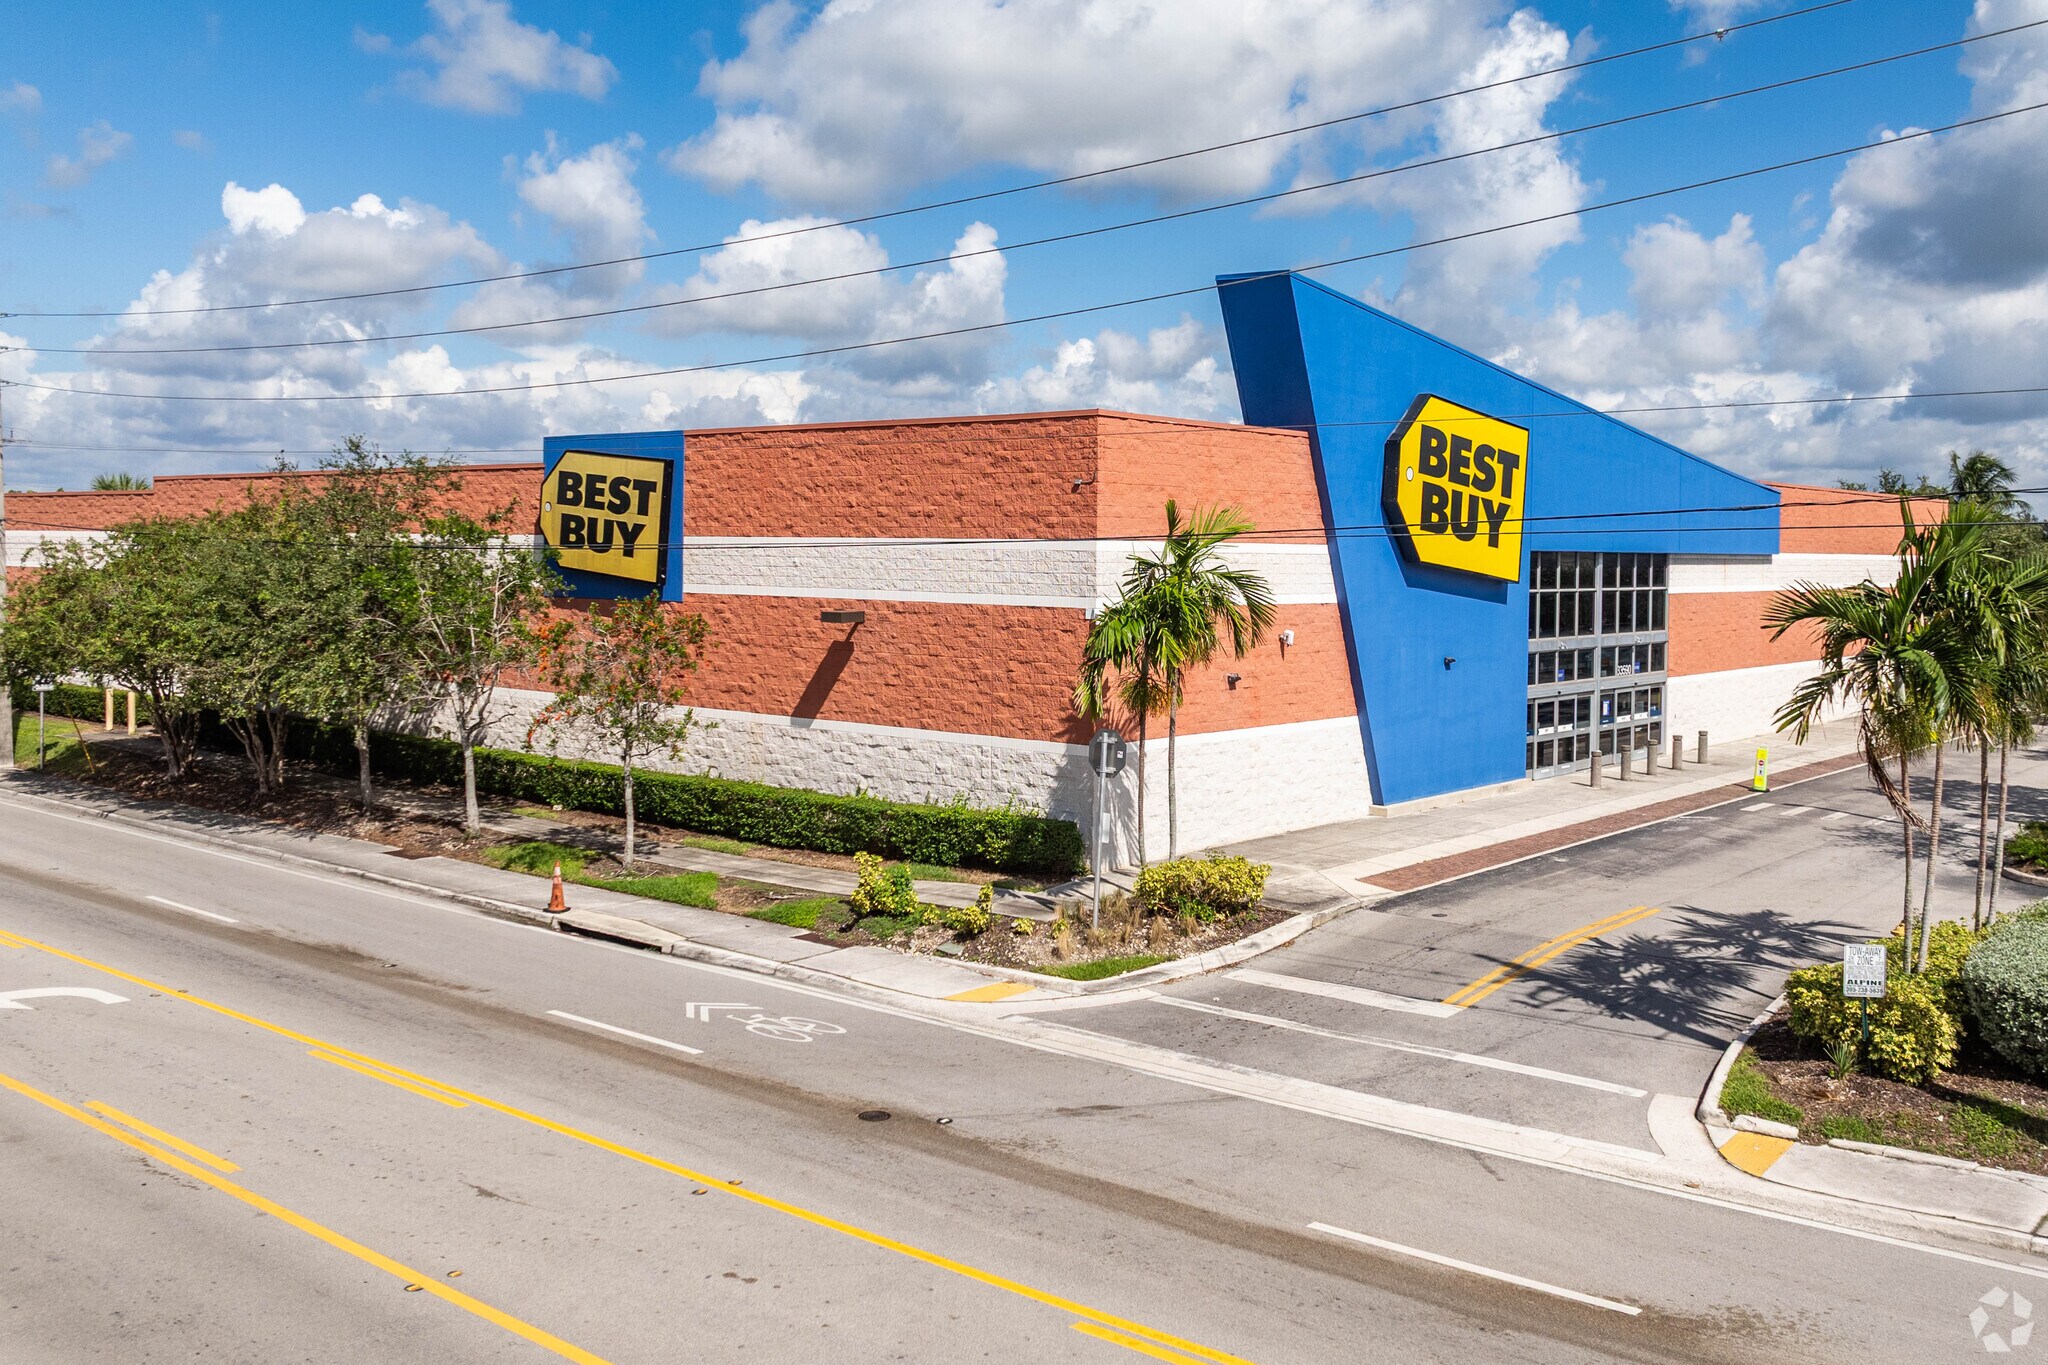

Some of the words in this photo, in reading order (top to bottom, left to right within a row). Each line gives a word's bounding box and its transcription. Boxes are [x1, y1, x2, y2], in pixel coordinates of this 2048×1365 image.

[1418, 424, 1520, 499] BEST
[557, 471, 657, 516] BEST
[1420, 481, 1511, 548] BUY
[560, 513, 647, 558] BUY
[1849, 946, 1881, 956] TOW-AWAY
[1857, 956, 1874, 965] ZONE
